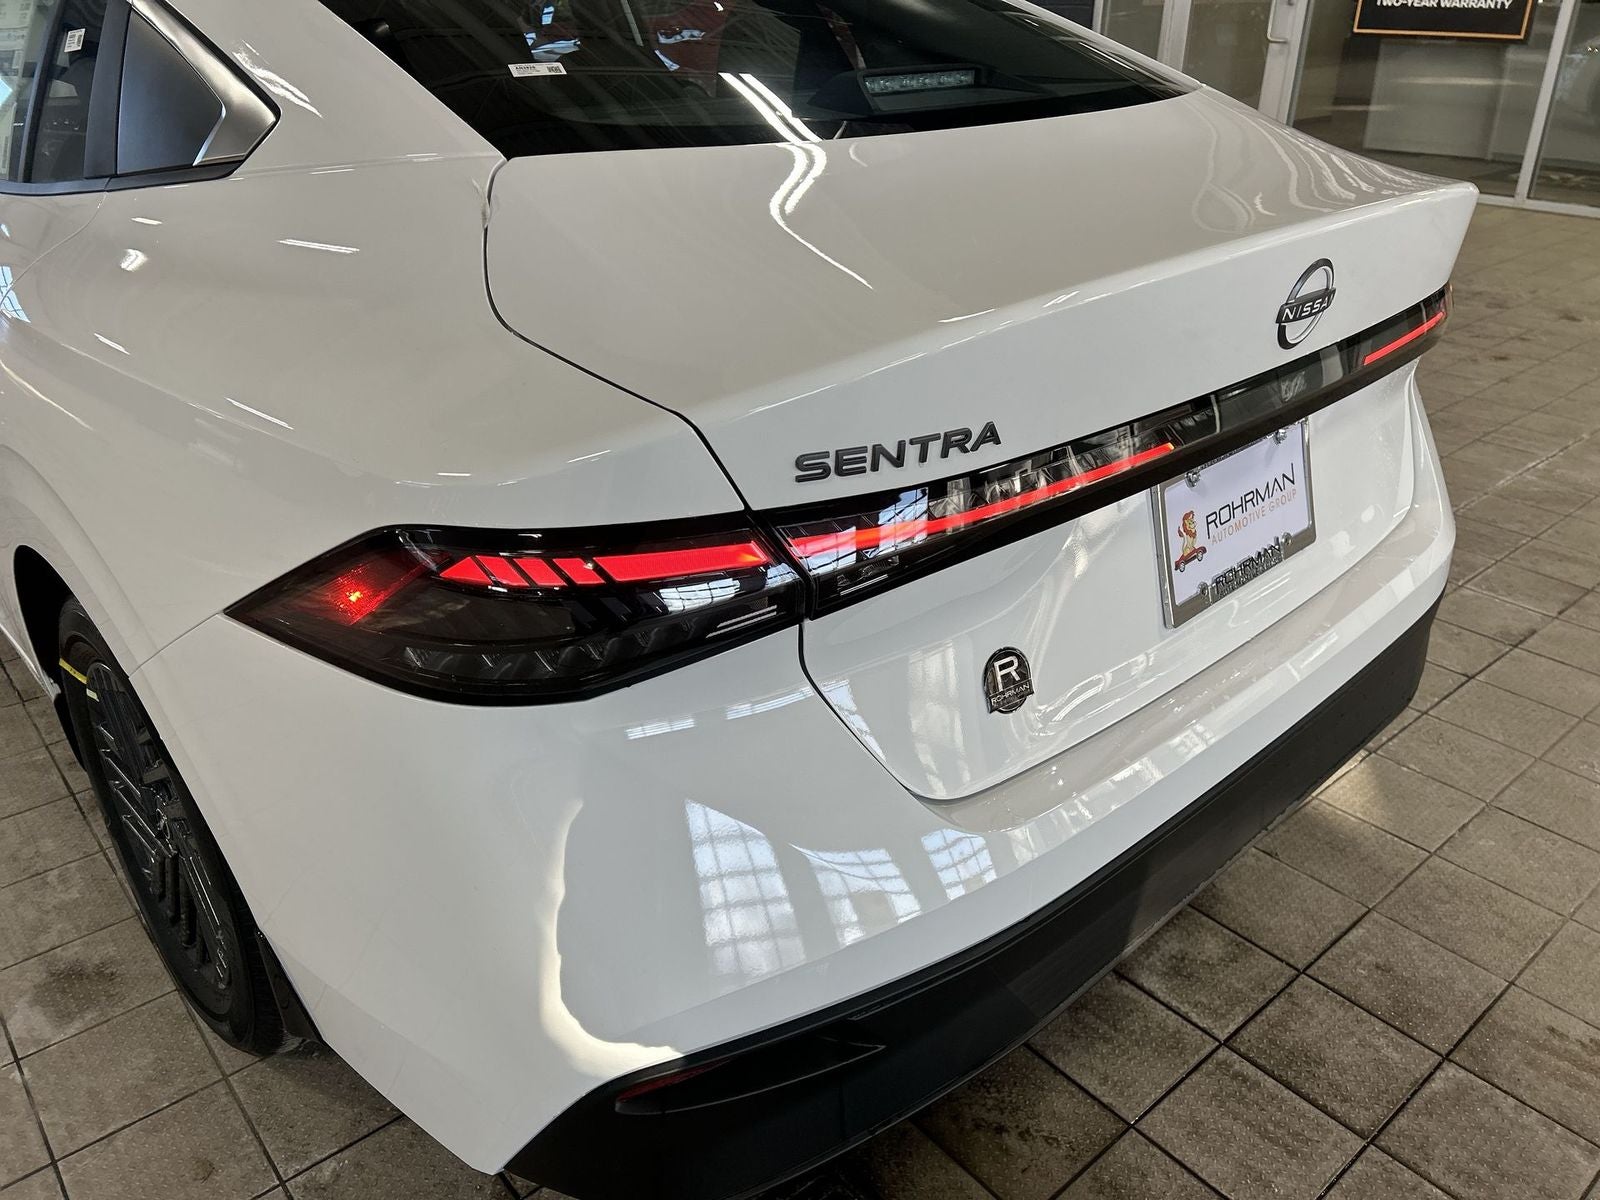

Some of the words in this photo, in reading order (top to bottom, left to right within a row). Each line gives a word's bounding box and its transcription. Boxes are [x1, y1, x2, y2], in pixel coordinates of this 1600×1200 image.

[1376, 0, 1438, 9] TWO-YEAR
[1440, 0, 1513, 10] WARRANTY
[795, 420, 1002, 483] SENTRA
[1205, 462, 1295, 540] ROHRMAN
[1211, 505, 1266, 545] AUTOMOTIVE
[1268, 488, 1297, 512] GROUP
[1212, 536, 1281, 595] ROHRMAN
[990, 682, 1030, 706] ROHRMAN
[993, 655, 1021, 692] R
